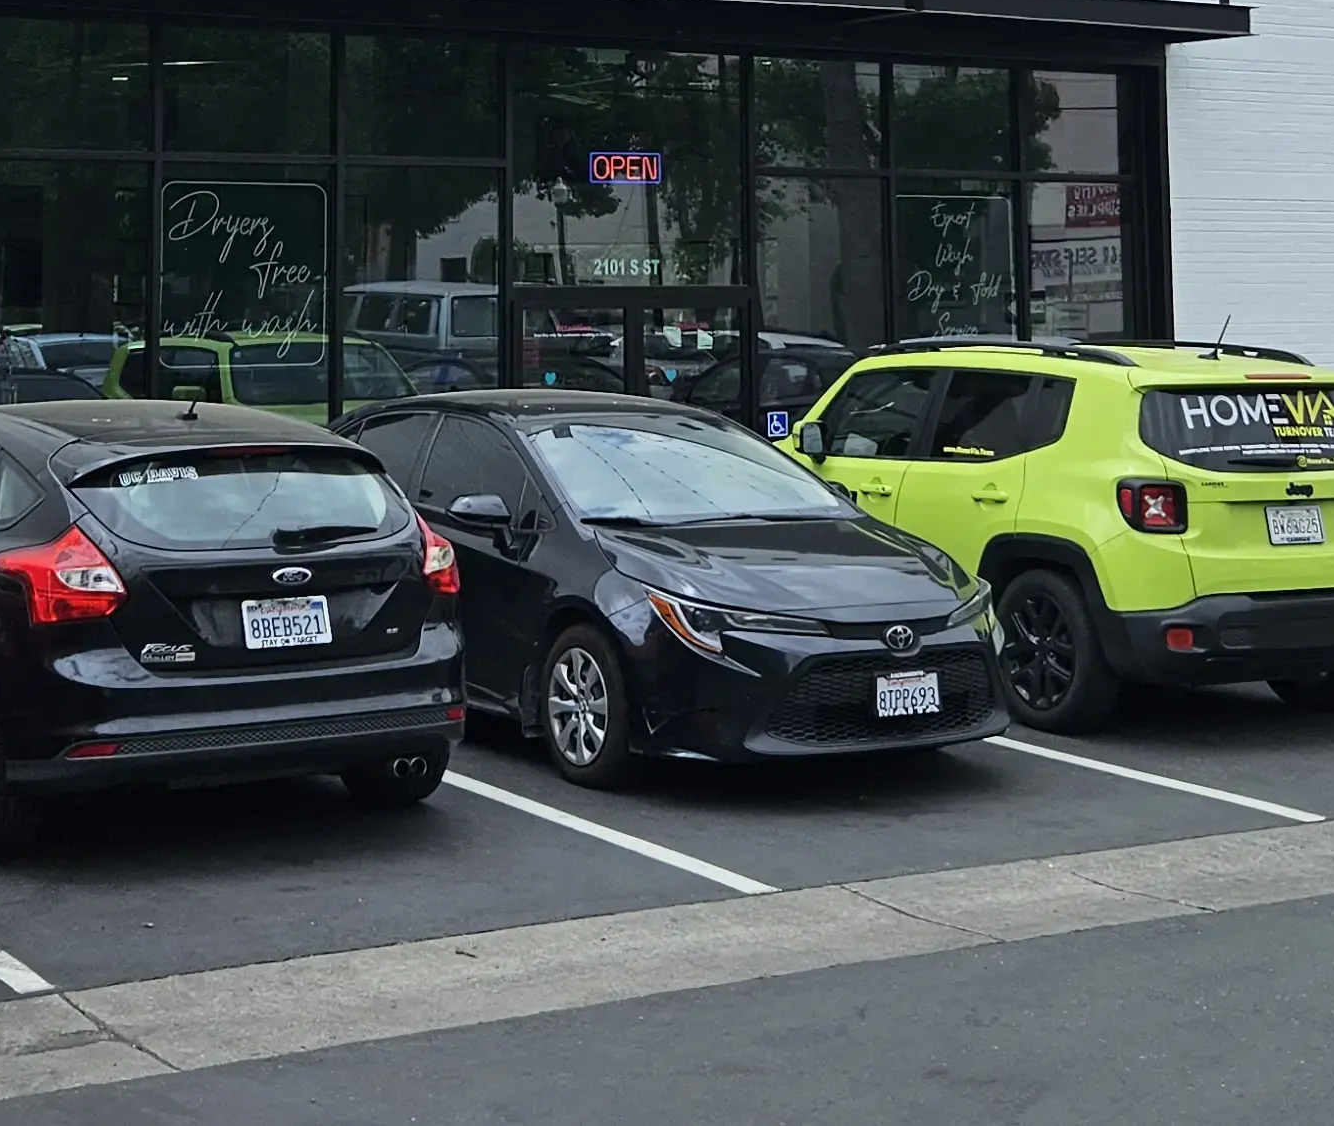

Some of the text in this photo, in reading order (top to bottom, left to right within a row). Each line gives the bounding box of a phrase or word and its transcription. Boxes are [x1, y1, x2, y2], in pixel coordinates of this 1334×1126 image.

[593, 155, 657, 180] OPEN
[168, 190, 274, 264] Dryers
[593, 259, 660, 275] 2101 S ST
[907, 270, 947, 314] Dry
[163, 289, 317, 359] with wash
[1273, 426, 1324, 437] TURNOVER
[119, 466, 199, 486] UC DAVIS
[251, 614, 324, 639] 8BEB521
[879, 686, 936, 711] 8TPP693
